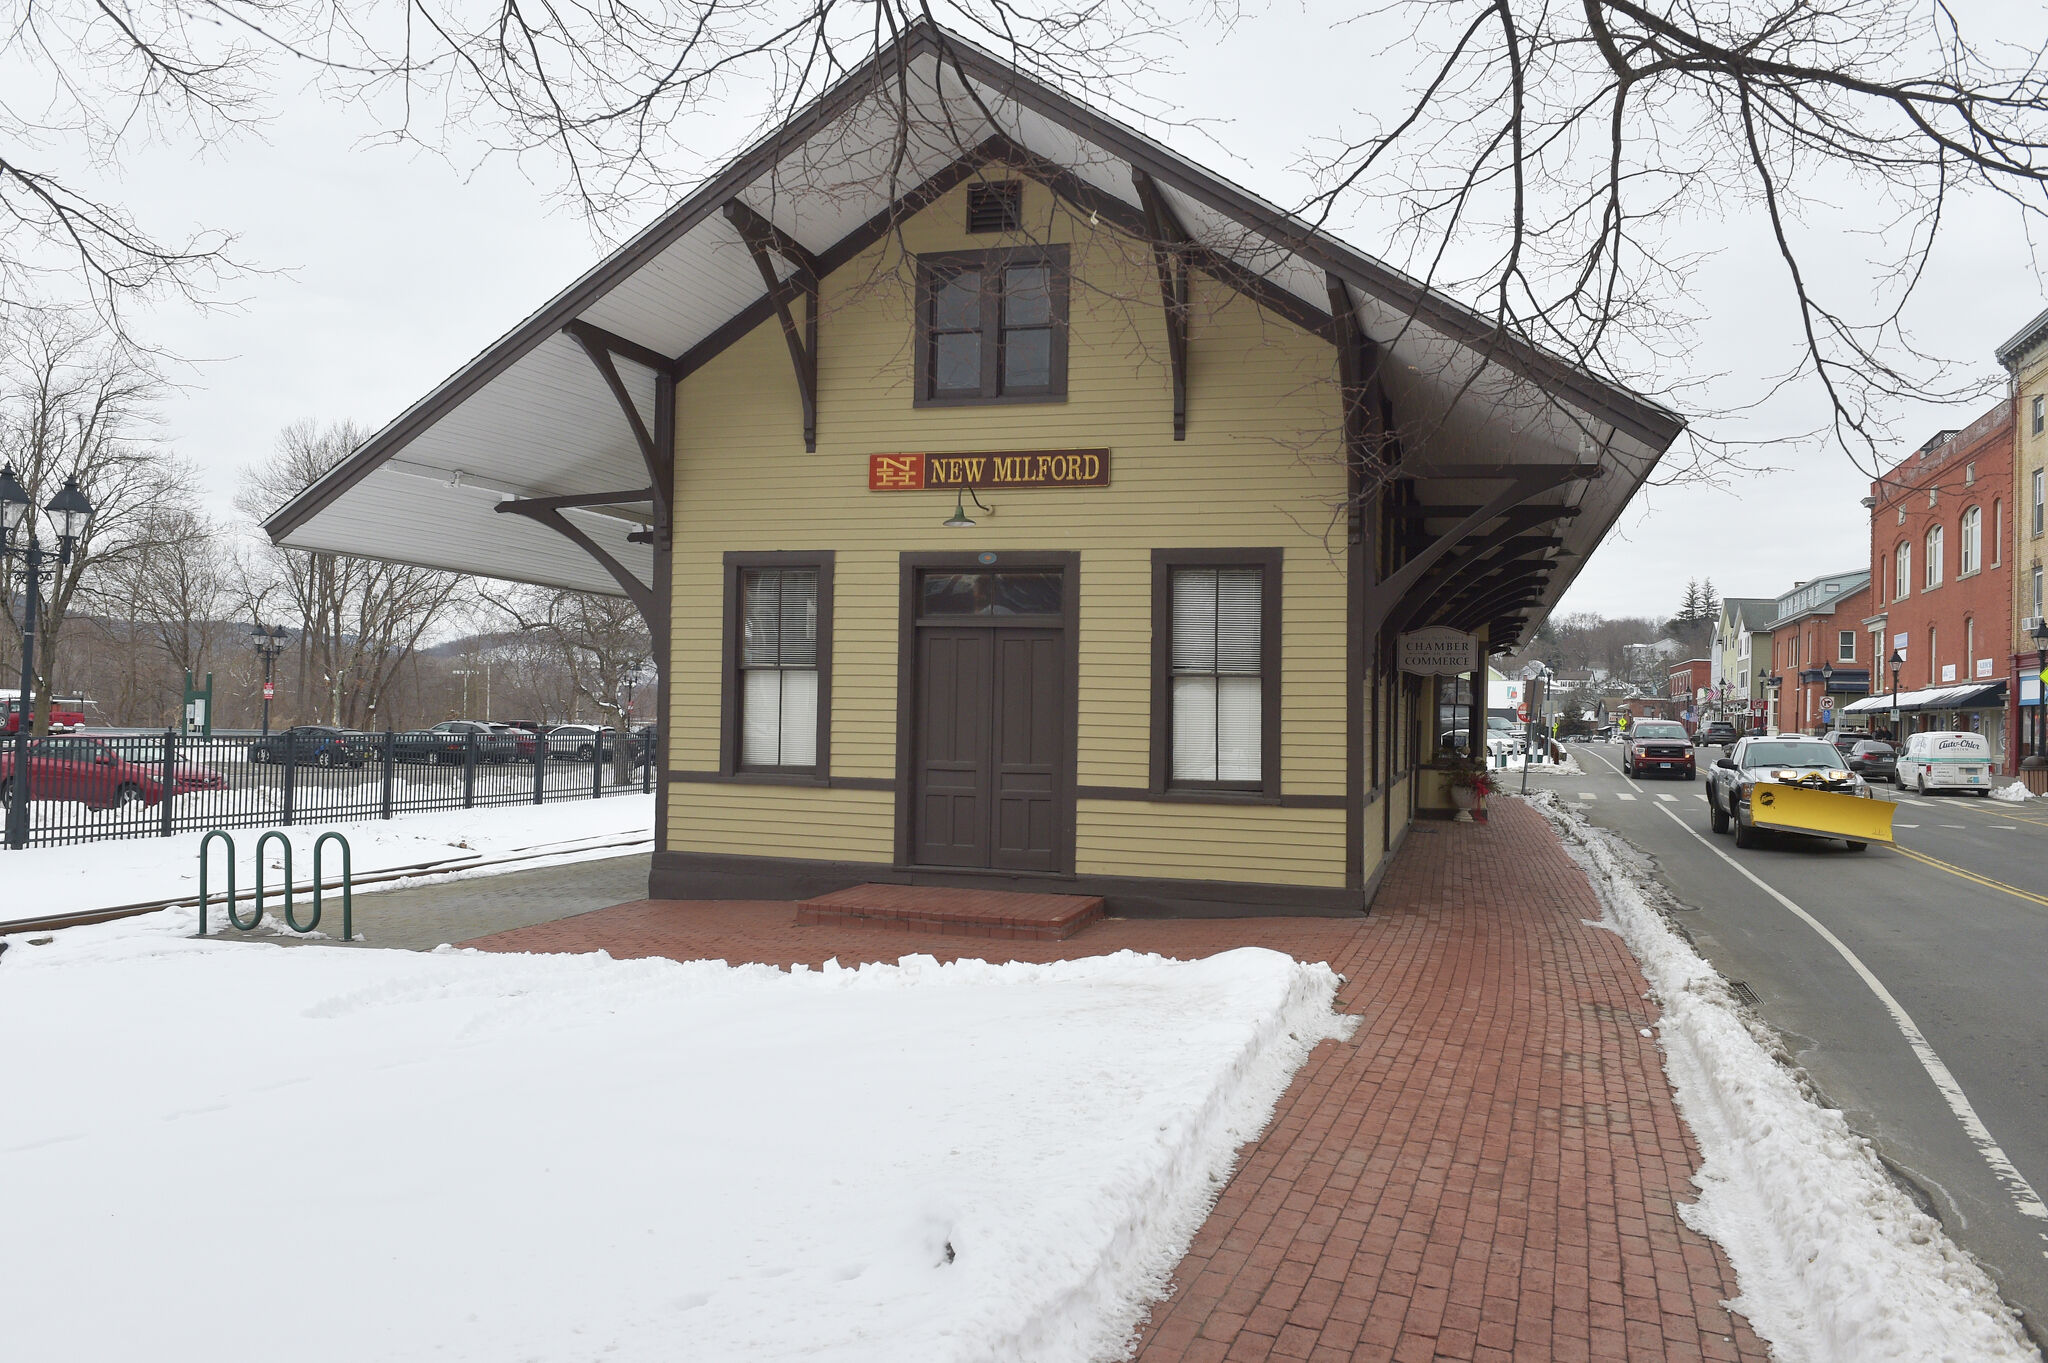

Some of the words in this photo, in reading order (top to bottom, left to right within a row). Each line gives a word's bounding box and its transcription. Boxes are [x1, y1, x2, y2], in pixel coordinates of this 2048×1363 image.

[931, 457, 987, 483] NEW
[992, 454, 1100, 483] MILFORD
[1406, 642, 1469, 651] CHAMBER
[1404, 656, 1470, 666] COMMERCE
[1938, 739, 1980, 750] Auto-Chlor
